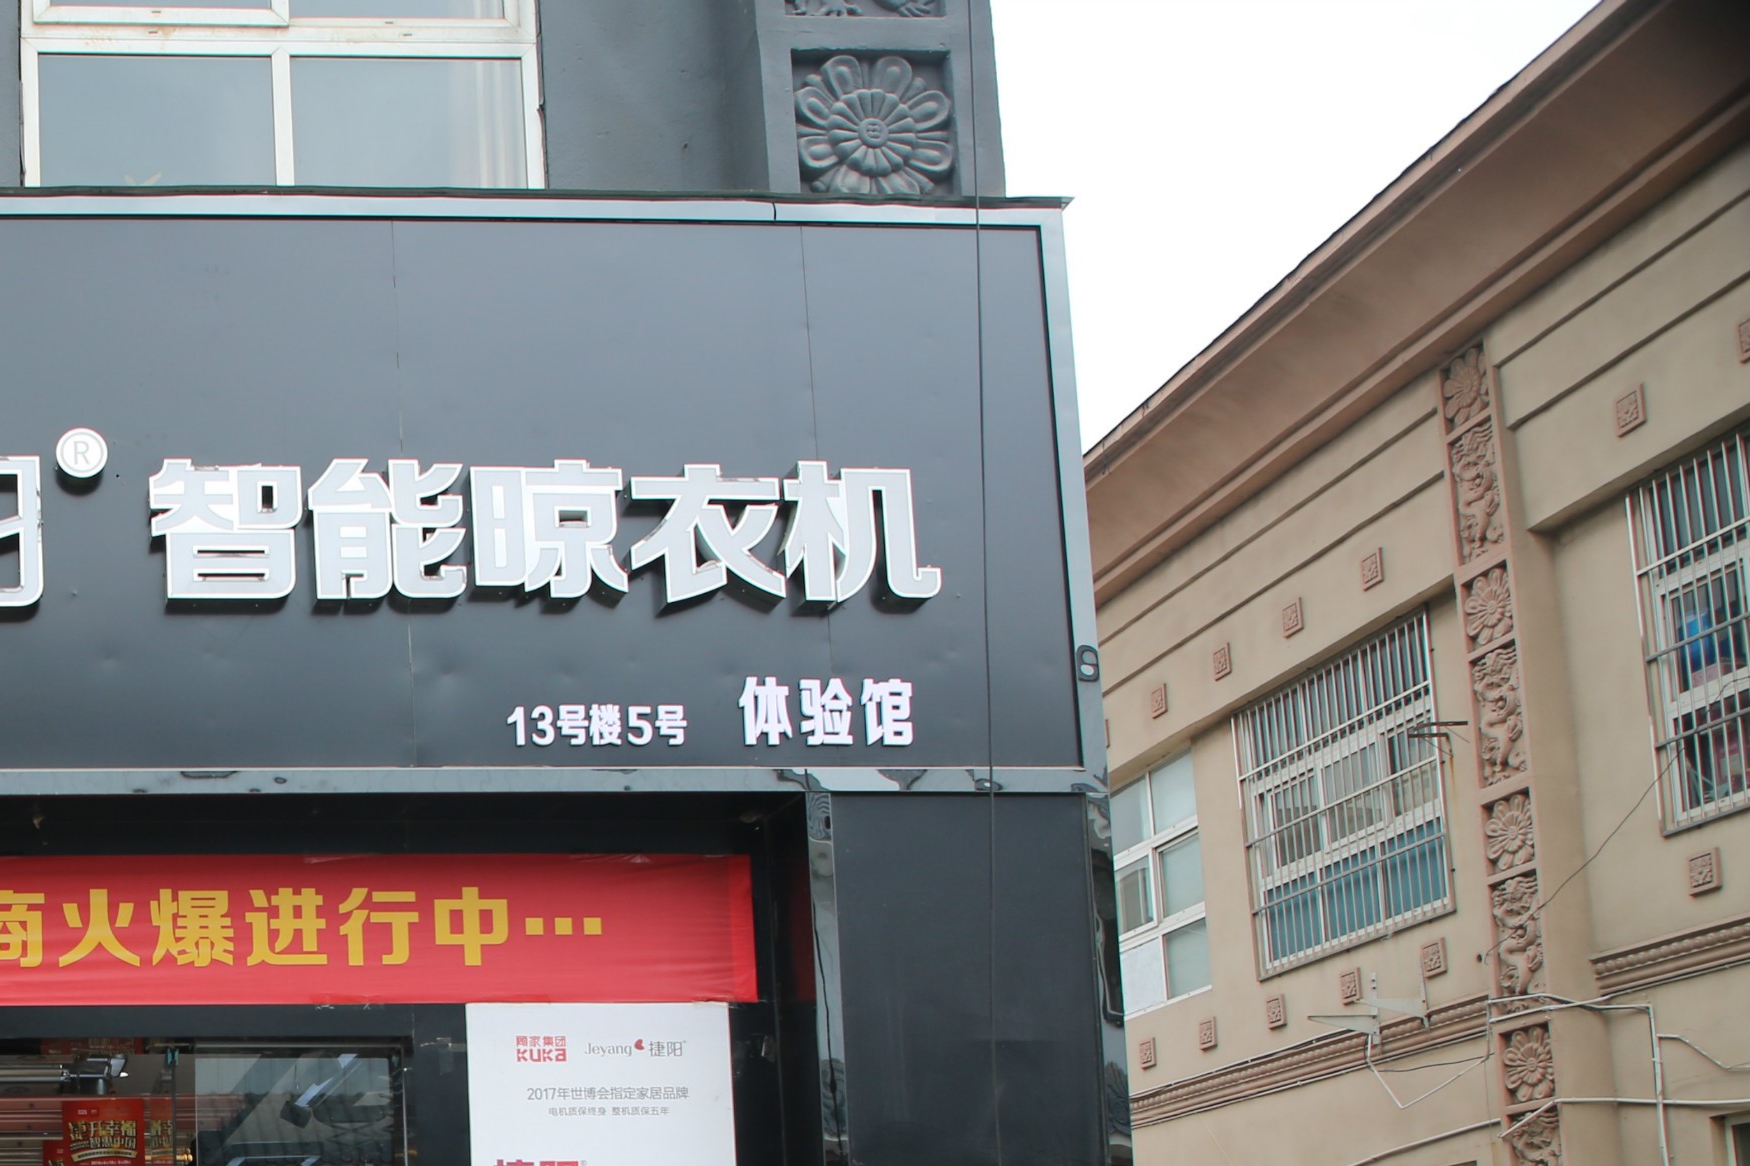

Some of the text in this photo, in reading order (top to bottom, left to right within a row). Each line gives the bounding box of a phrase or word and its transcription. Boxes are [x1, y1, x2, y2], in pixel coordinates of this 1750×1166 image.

[148, 457, 943, 605] 智能晾衣机
[506, 676, 915, 748] 13号楼5号 体验馆
[584, 1040, 683, 1057] Jeyang 捷阳
[526, 1086, 690, 1101] 2017年世博会指定家居品牌
[548, 1106, 670, 1116] 电机质保终身 整机质保五年
